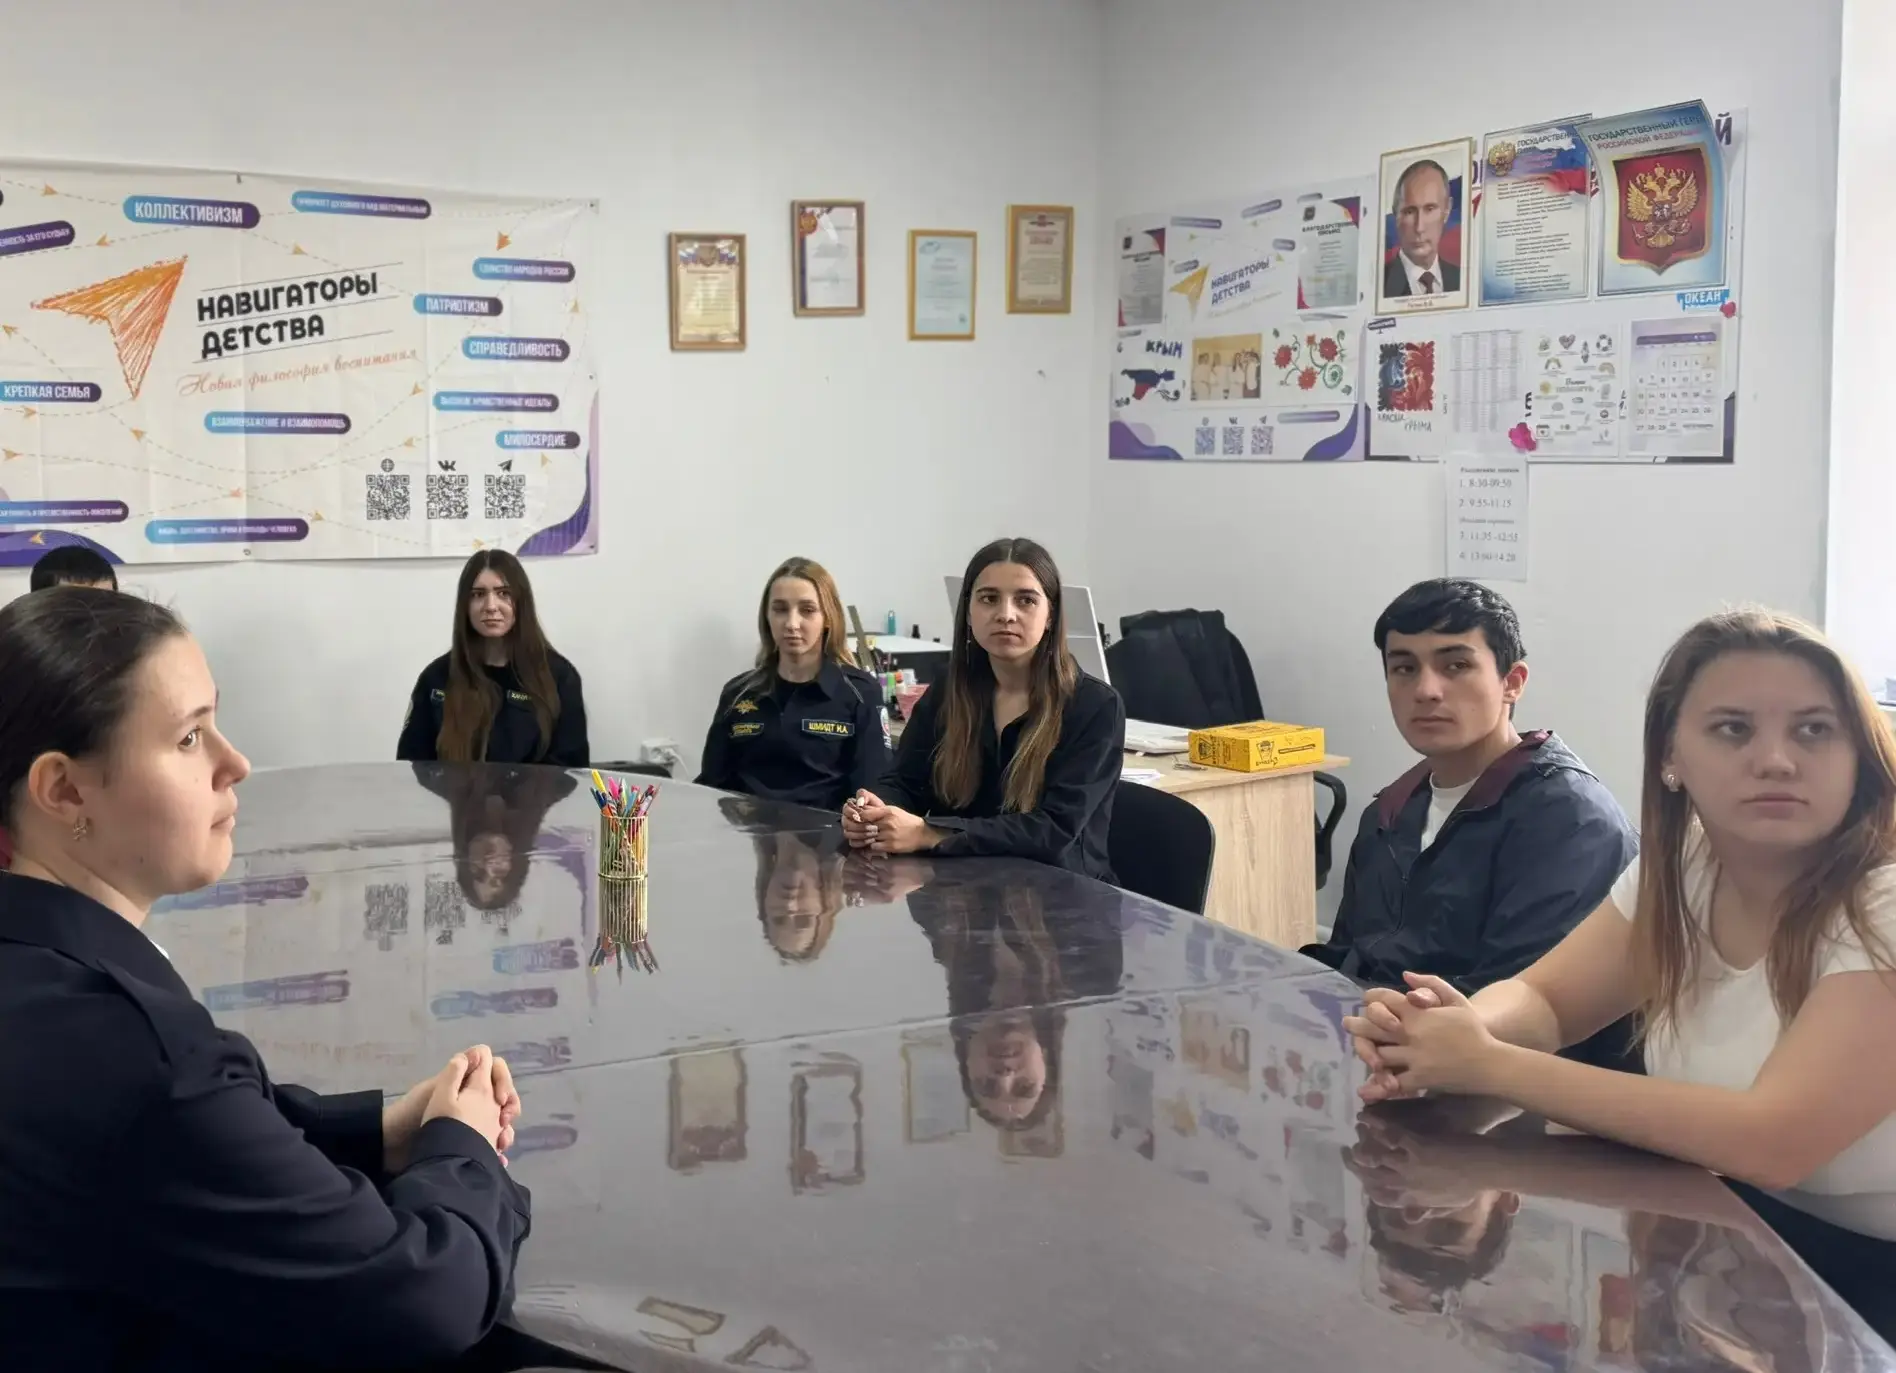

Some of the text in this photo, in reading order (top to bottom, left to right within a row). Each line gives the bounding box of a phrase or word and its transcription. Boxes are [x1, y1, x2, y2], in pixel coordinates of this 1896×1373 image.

[1588, 121, 1678, 143] ГОСУДАРСТВЕННЫЙ
[135, 201, 244, 224] КОЛЛЕКТИВИЗМ
[1211, 258, 1270, 289] НАВИГАТОРЫ
[197, 272, 378, 322] НАВИГАТОРЫ
[1211, 280, 1251, 305] ДЕТСТВА
[1684, 291, 1721, 304] ОКЕАН
[425, 297, 489, 313] ПАТРИОТИЗМ
[201, 314, 325, 360] ДЕТСТВА
[469, 340, 563, 358] СПРАВЕДЛИВОСТЬ
[1145, 340, 1183, 359] КРЫМ
[177, 348, 421, 397] Новая философия воспитания
[3, 384, 91, 399] КРЕПКАЯ СЕМЬЯ
[503, 434, 566, 448] МИЛОСЕРДИЕ
[808, 721, 836, 733] ШМИДТ
